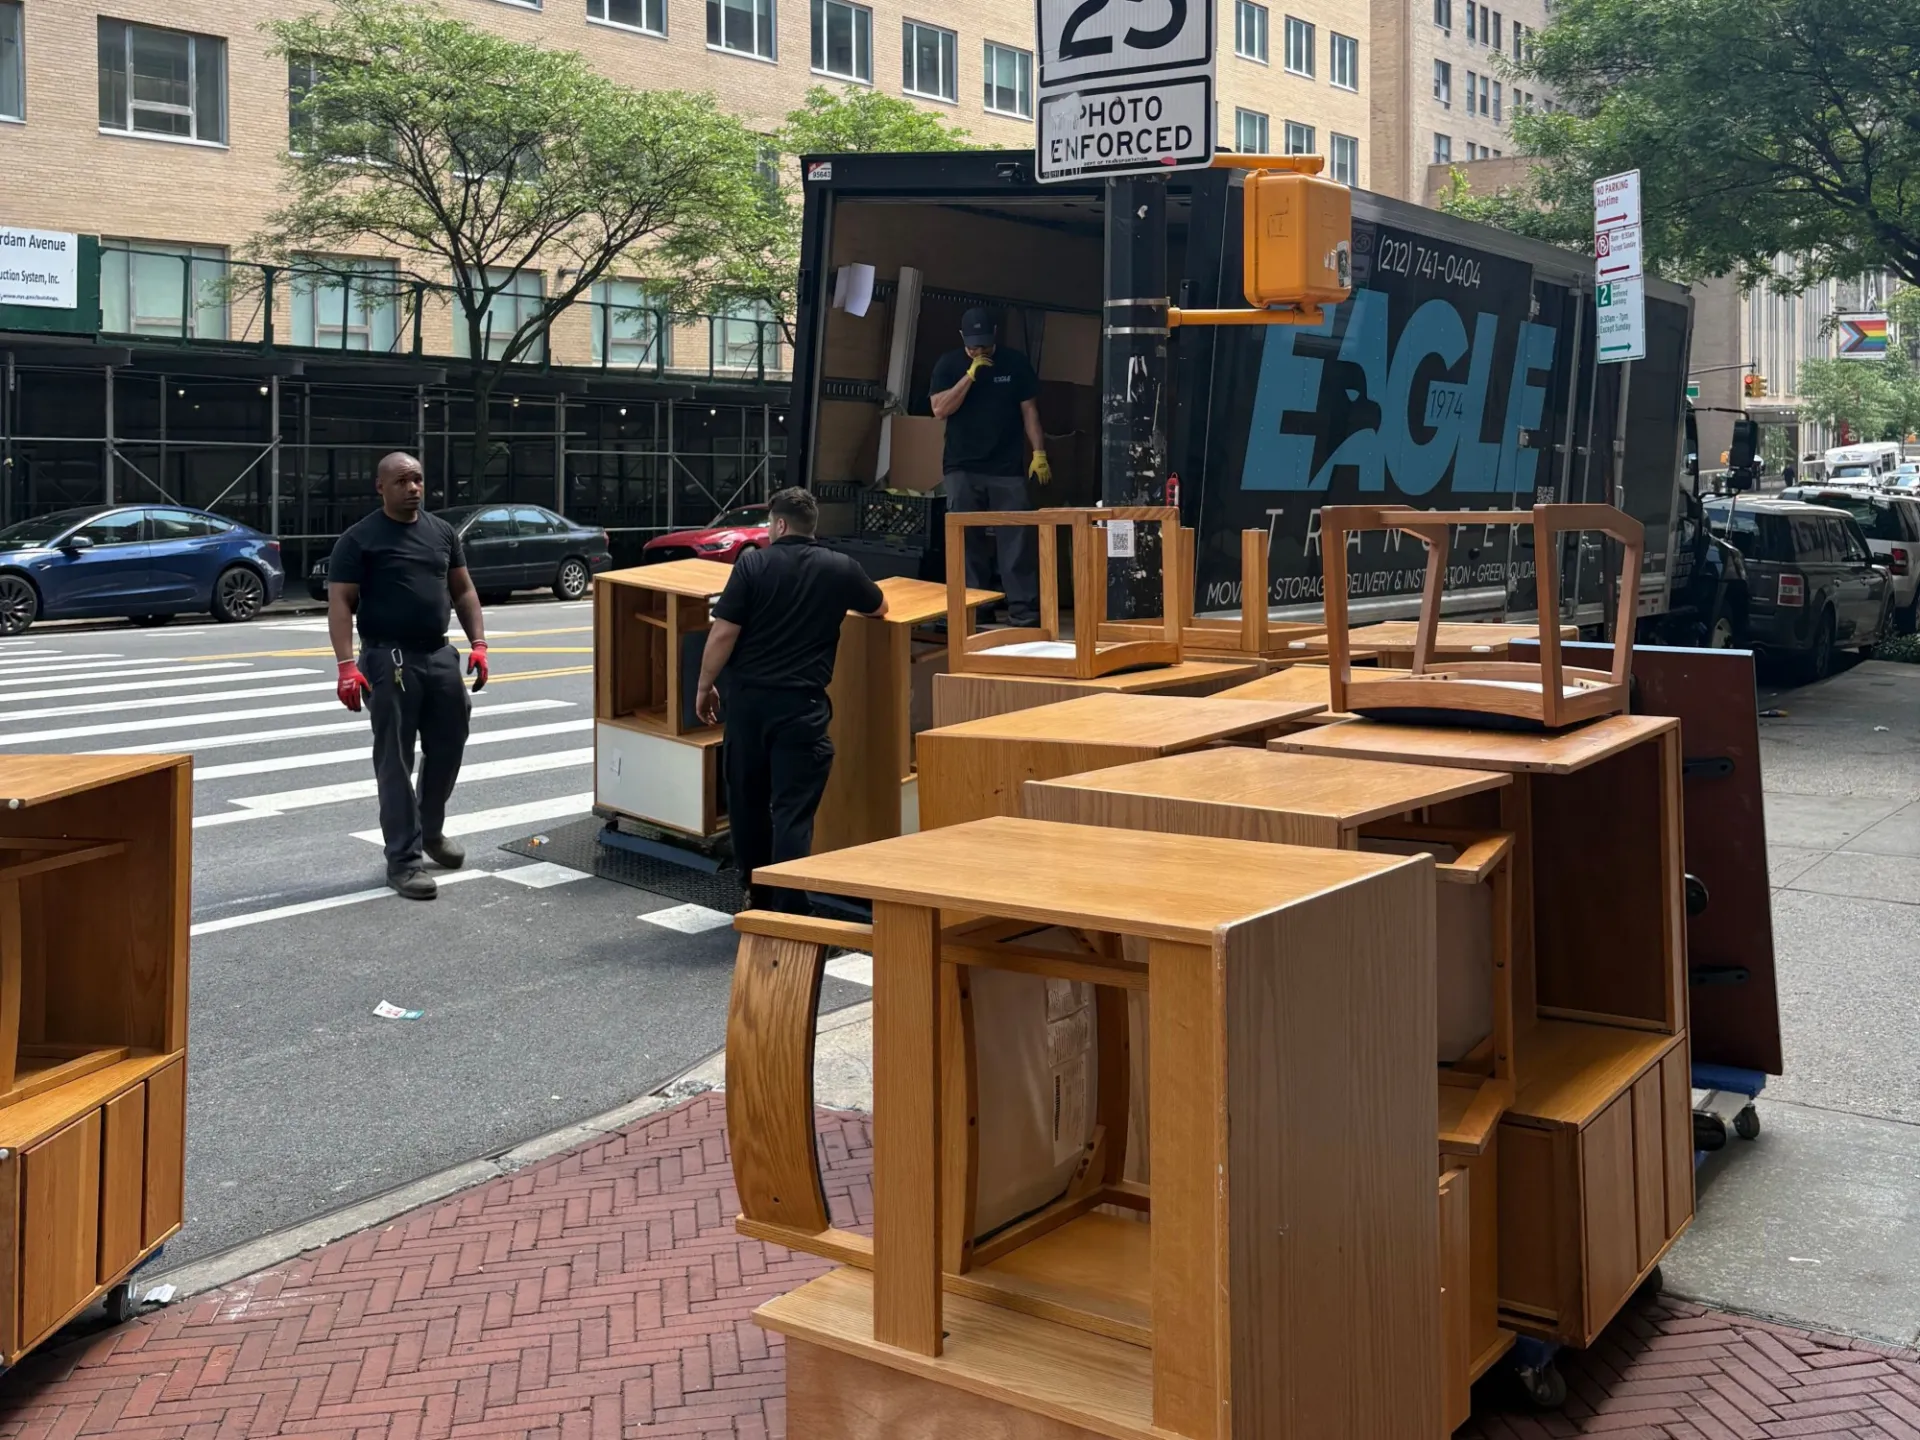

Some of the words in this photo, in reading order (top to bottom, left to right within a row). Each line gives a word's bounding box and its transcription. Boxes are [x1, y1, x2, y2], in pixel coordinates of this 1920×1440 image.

[1051, 125, 1192, 164] ENFORCED
[1596, 185, 1604, 196] NO
[1605, 179, 1628, 193] PARKING
[1598, 196, 1619, 208] Anytime
[29, 235, 66, 251] Avenue
[1378, 235, 1412, 277] (212)
[1415, 247, 1481, 289] 741-0404
[21, 270, 47, 285] System,
[48, 273, 60, 284] Inc.
[1600, 284, 1608, 305] 2
[1600, 324, 1614, 334] Except
[1615, 322, 1631, 332] Sunday
[1241, 288, 1557, 495] EAGLE
[1430, 389, 1463, 420] 1974
[1265, 506, 1521, 558] TRANFER
[1275, 575, 1325, 600] STORAG
[1477, 563, 1505, 583] GREEN
